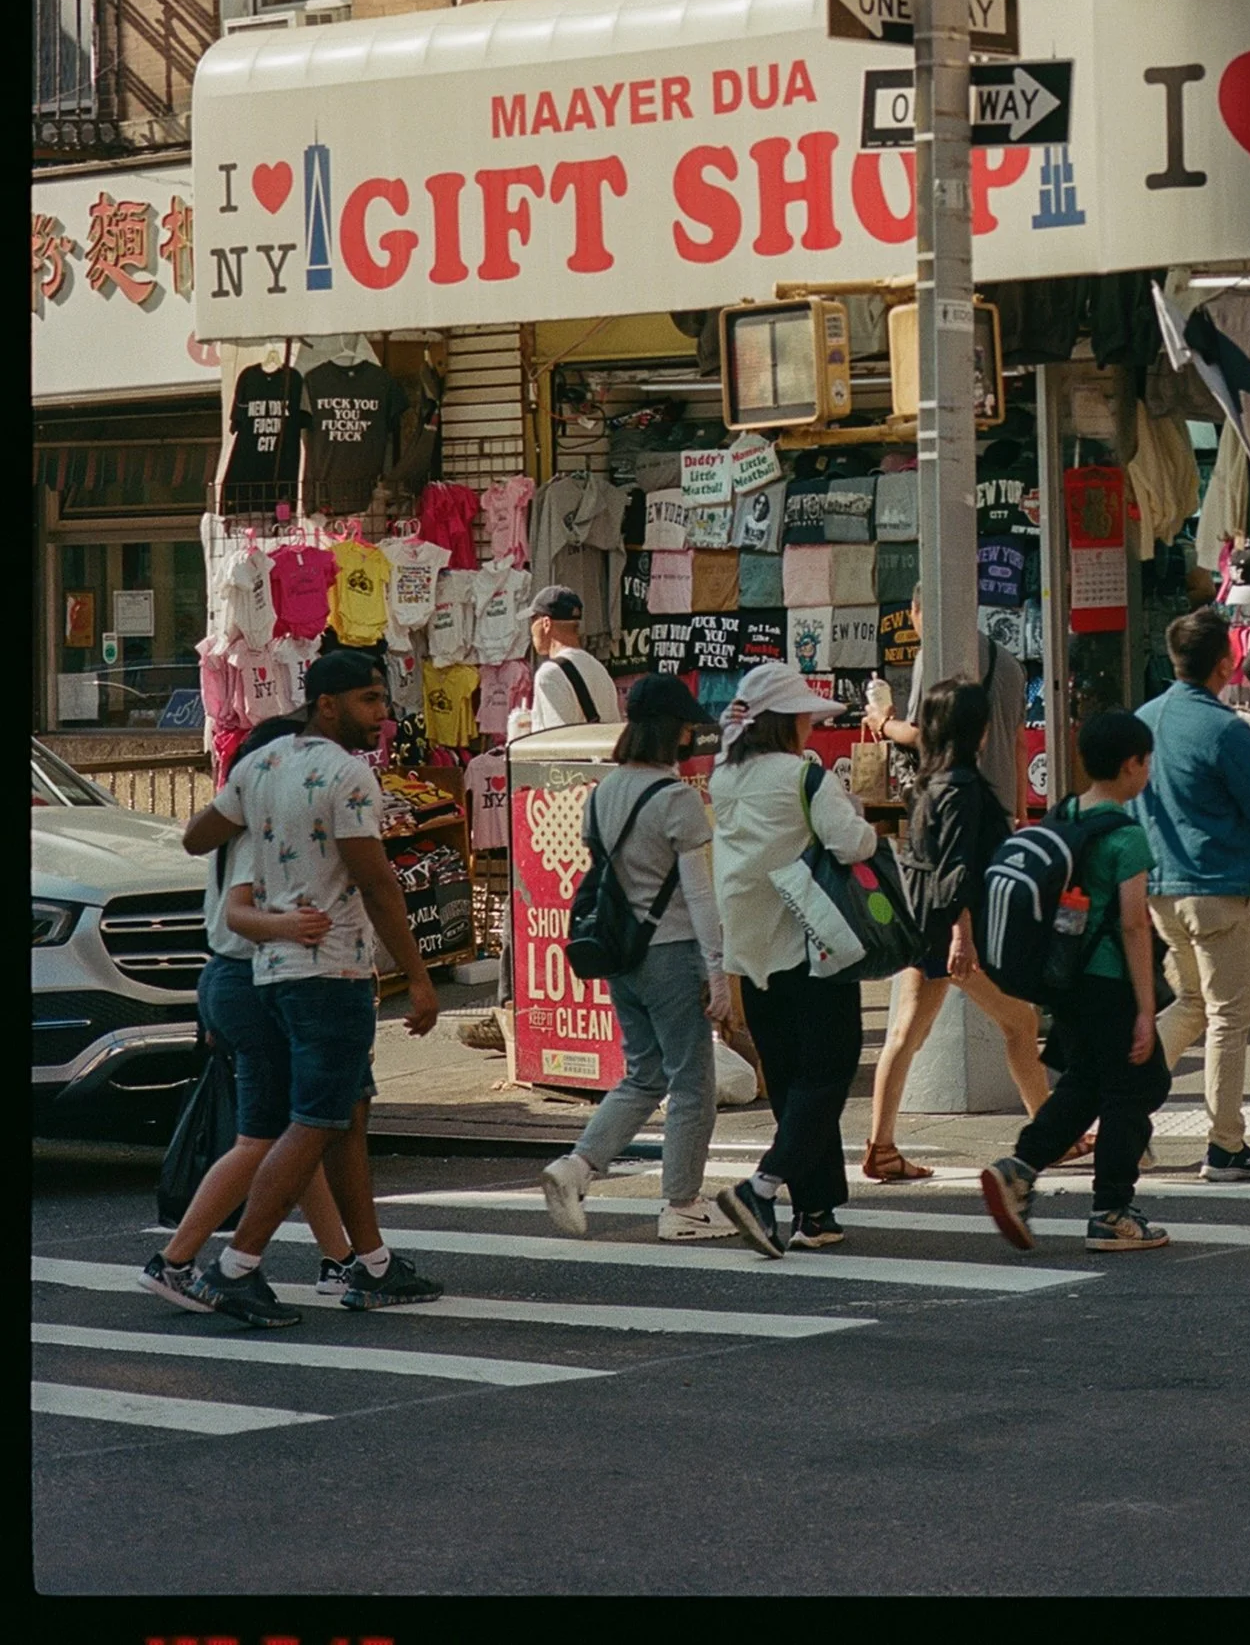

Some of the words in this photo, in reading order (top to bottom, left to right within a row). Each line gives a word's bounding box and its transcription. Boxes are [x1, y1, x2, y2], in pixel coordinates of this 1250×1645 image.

[492, 75, 693, 139] MAAYER
[712, 59, 817, 115] DUA
[978, 88, 1040, 122] WAY
[1144, 63, 1208, 190] I
[218, 162, 239, 214] I
[339, 155, 628, 290] GIFT
[672, 131, 1031, 264] SHOP
[210, 243, 297, 299] NY
[317, 398, 350, 410] FUCK
[353, 399, 379, 410] YOU
[334, 409, 360, 420] YOU
[329, 431, 362, 442] FUCK
[684, 453, 725, 468] Daddy's
[976, 479, 997, 508] EW
[832, 624, 849, 642] EW
[853, 621, 875, 642] YOR
[484, 776, 491, 792] I
[482, 793, 506, 809] NY
[556, 1007, 613, 1041] CLEAN
